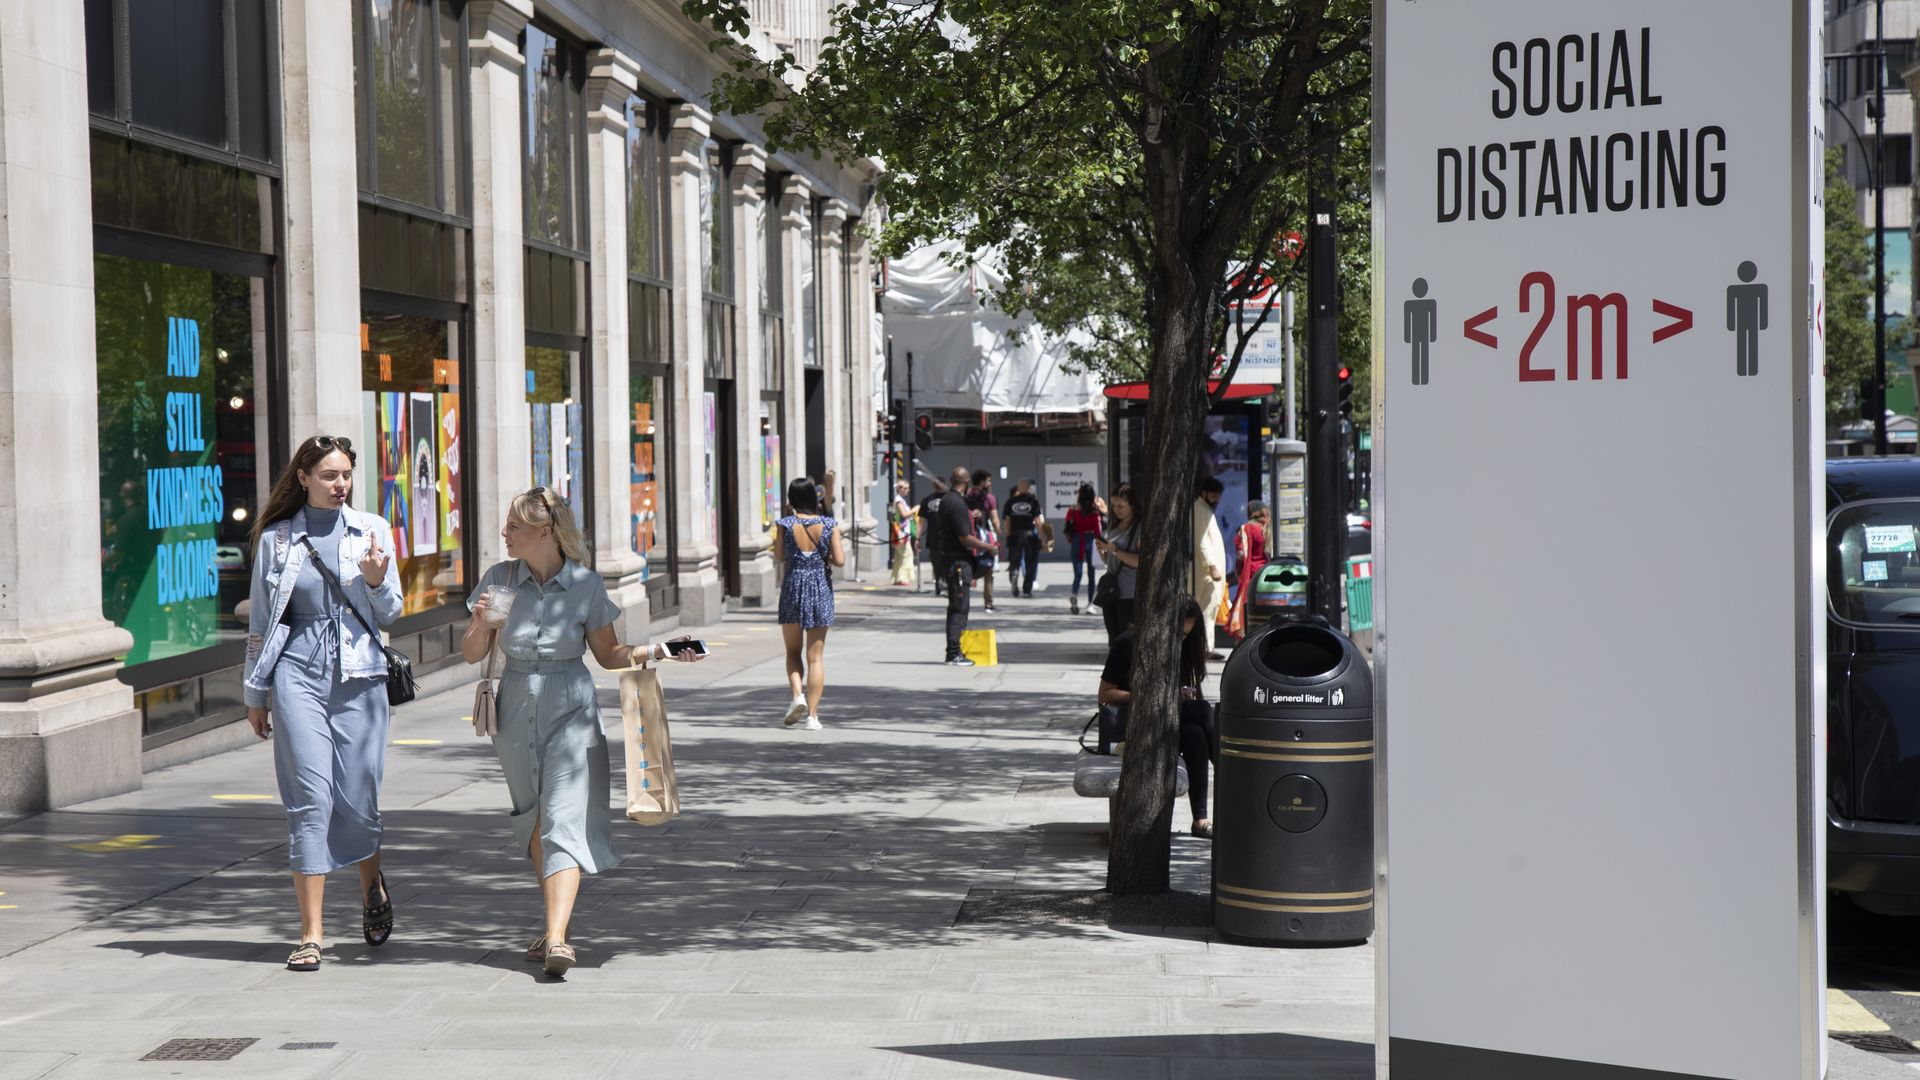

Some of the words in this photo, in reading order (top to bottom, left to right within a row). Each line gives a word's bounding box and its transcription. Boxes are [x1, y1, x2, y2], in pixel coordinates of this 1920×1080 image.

[1491, 26, 1662, 120] SOCIAL
[1437, 125, 1726, 223] DISTANCING
[167, 316, 200, 378] AND
[1519, 271, 1628, 382] 2m
[166, 391, 205, 452] STILL
[147, 464, 224, 530] KINDNESS
[157, 538, 219, 605] BLOOMS
[1272, 693, 1303, 704] general
[1305, 694, 1324, 704] litter
